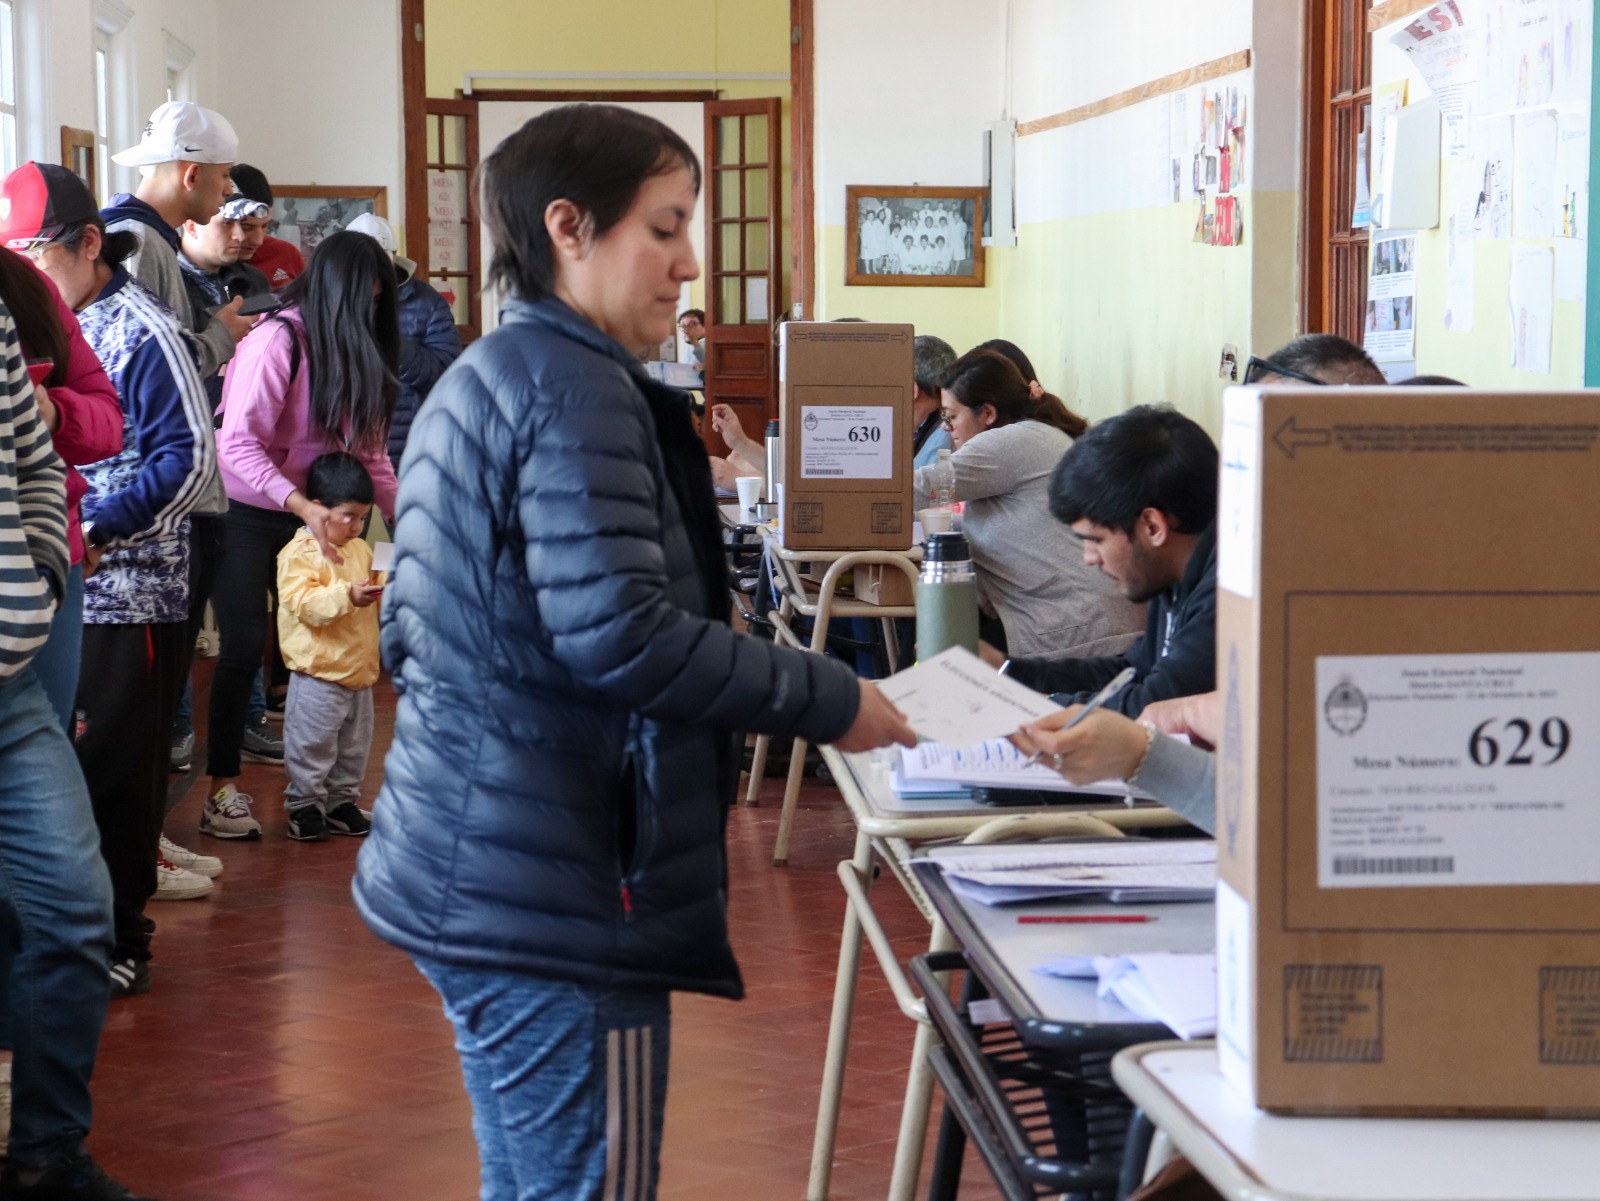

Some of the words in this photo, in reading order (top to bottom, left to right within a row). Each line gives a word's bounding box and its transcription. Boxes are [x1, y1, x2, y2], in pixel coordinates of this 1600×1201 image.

[848, 425, 881, 443] 630
[1353, 757, 1391, 769] Mesa
[1468, 716, 1571, 768] 629
